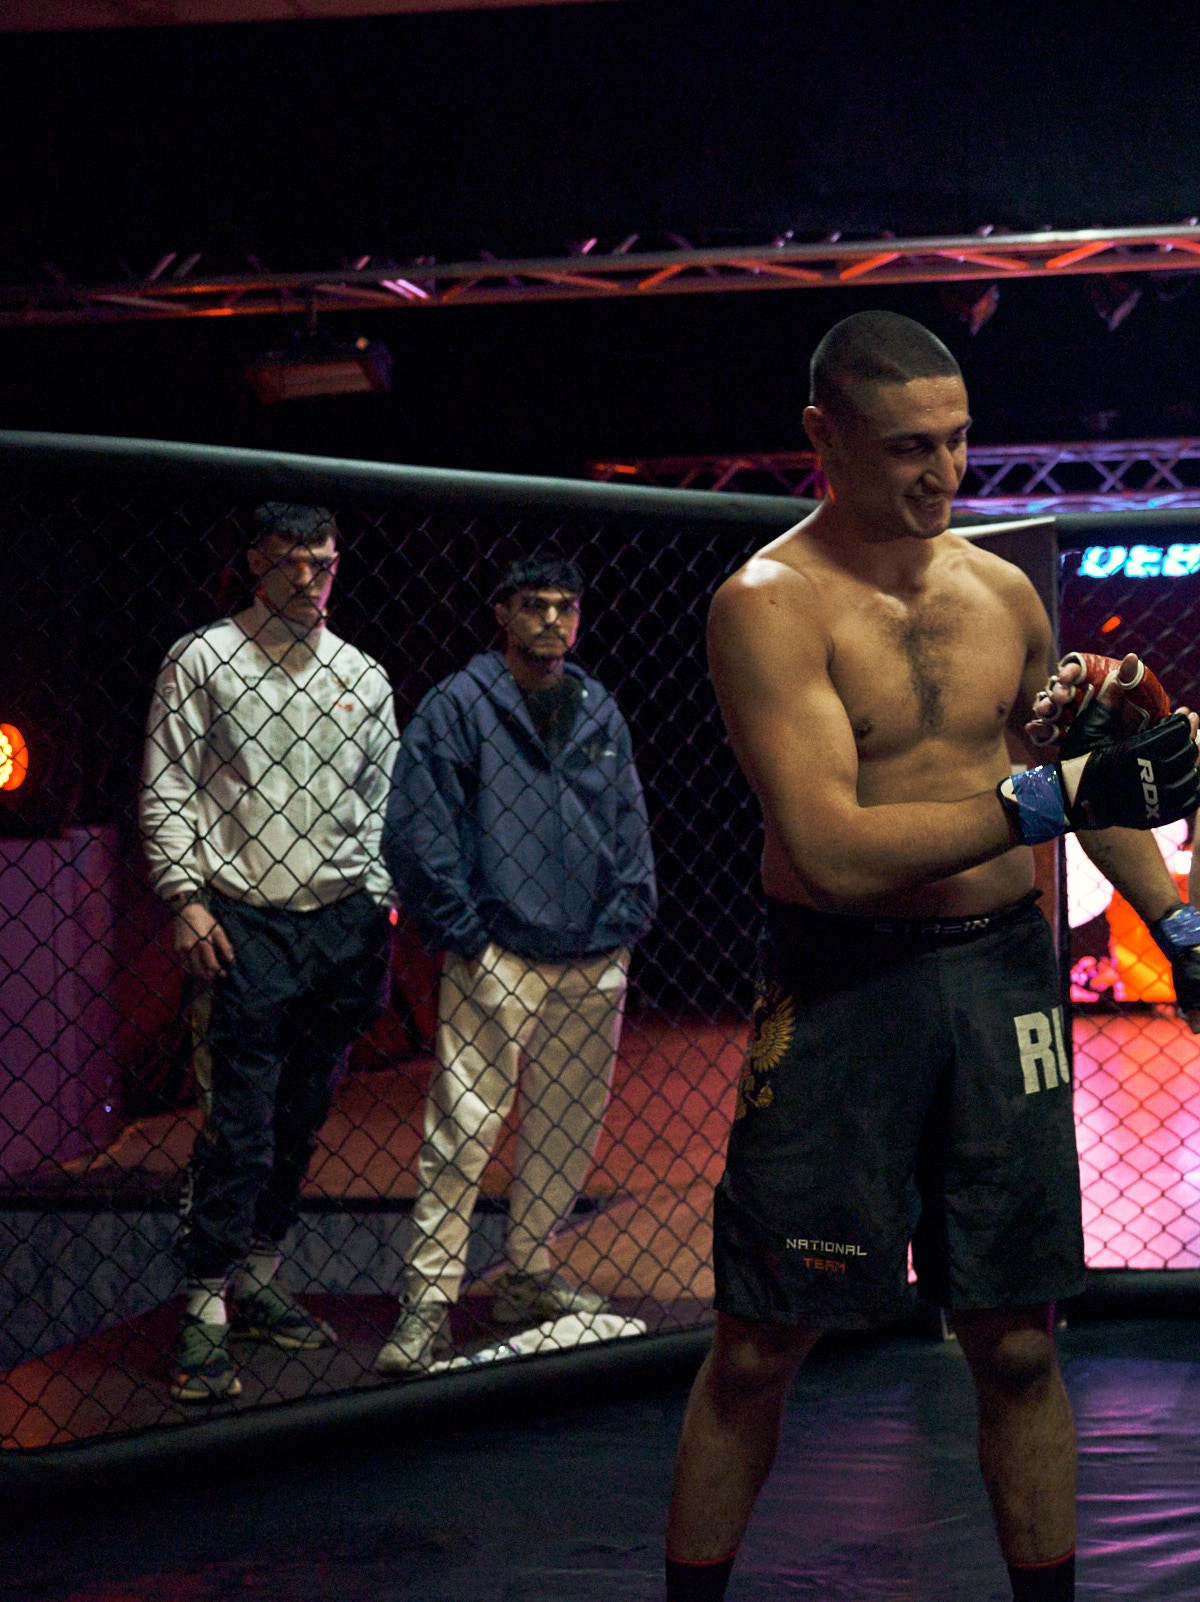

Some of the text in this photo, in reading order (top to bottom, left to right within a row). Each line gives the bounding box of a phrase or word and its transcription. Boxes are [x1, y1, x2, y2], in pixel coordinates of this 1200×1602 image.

[1136, 757, 1160, 820] RDX
[785, 1238, 868, 1256] NATIONAL
[803, 1257, 847, 1273] TEAM
